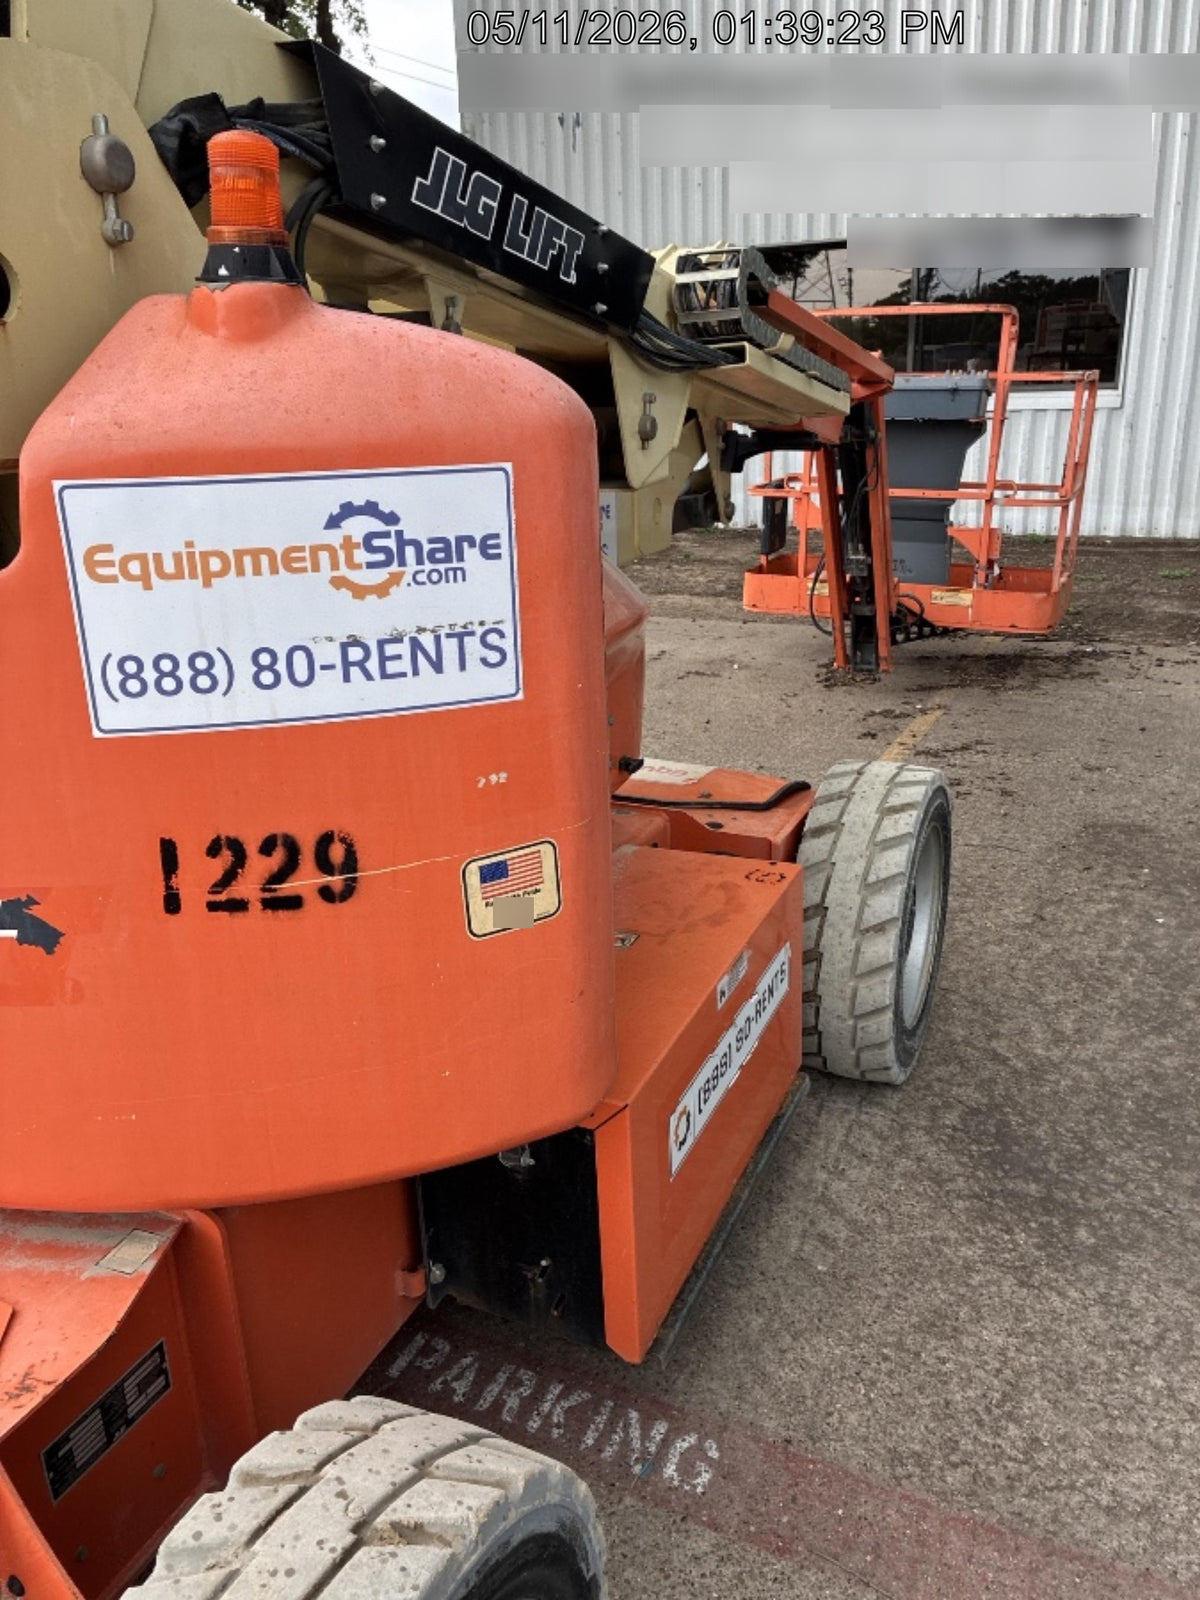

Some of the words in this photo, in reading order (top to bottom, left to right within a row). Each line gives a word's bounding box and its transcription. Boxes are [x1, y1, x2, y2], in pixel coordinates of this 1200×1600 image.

[411, 146, 502, 240] JLG
[503, 193, 586, 284] LIFT
[83, 529, 502, 591] EquipmentShare
[405, 566, 467, 588] .com
[100, 647, 235, 702] (888)
[250, 627, 508, 691] 80-RENTS
[159, 830, 358, 915] 1229
[385, 1331, 720, 1494] PARKING
